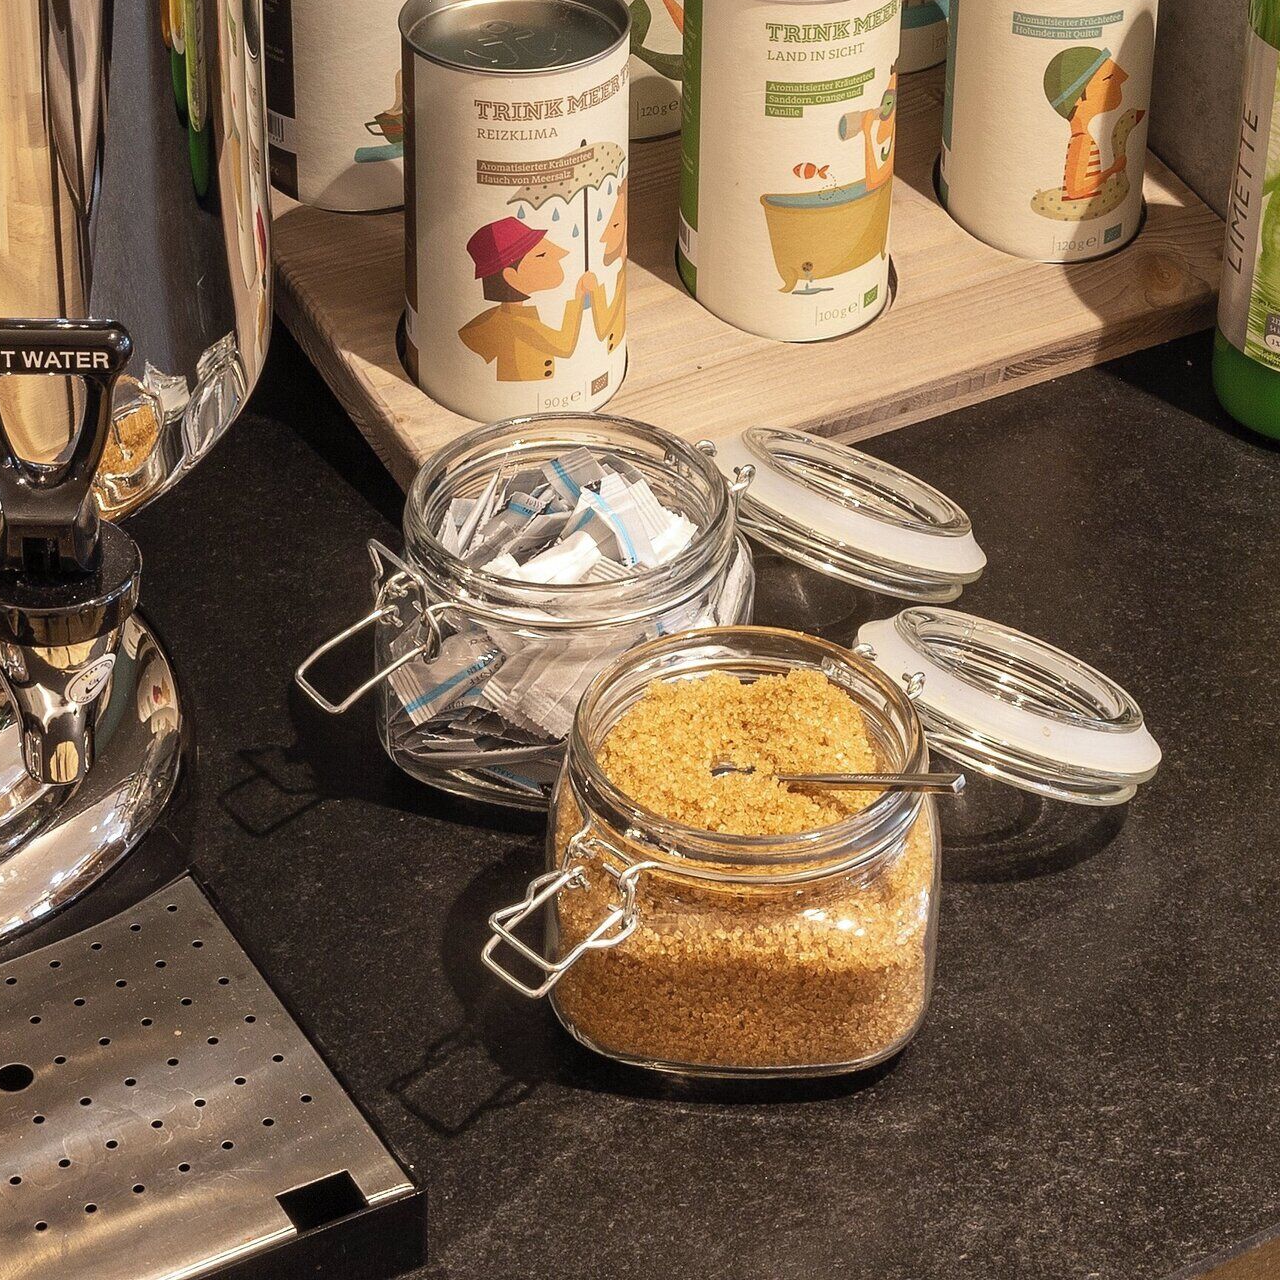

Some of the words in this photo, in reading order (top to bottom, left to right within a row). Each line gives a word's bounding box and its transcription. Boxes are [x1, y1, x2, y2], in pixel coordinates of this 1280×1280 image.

[765, 19, 851, 44] TRINK
[1015, 27, 1059, 39] Holunder
[767, 50, 808, 62] LAND
[810, 50, 826, 62] IN
[828, 42, 866, 61] SICHT
[768, 82, 834, 93] Aromatisierter
[768, 95, 815, 106] Sanddorn,
[815, 91, 846, 104] Orange
[846, 87, 862, 98] und
[474, 97, 564, 122] TRINK
[566, 74, 621, 116] MEER
[768, 106, 801, 117] Vanille
[476, 127, 559, 142] REIZKLIMA
[479, 161, 548, 173] Aromatisierter
[548, 151, 593, 169] Kräutertee
[479, 173, 511, 185] Hauch
[512, 174, 530, 185] von
[530, 169, 572, 183] Meersalz
[1226, 102, 1259, 275] LIMETTE
[21, 350, 111, 370] WATER
